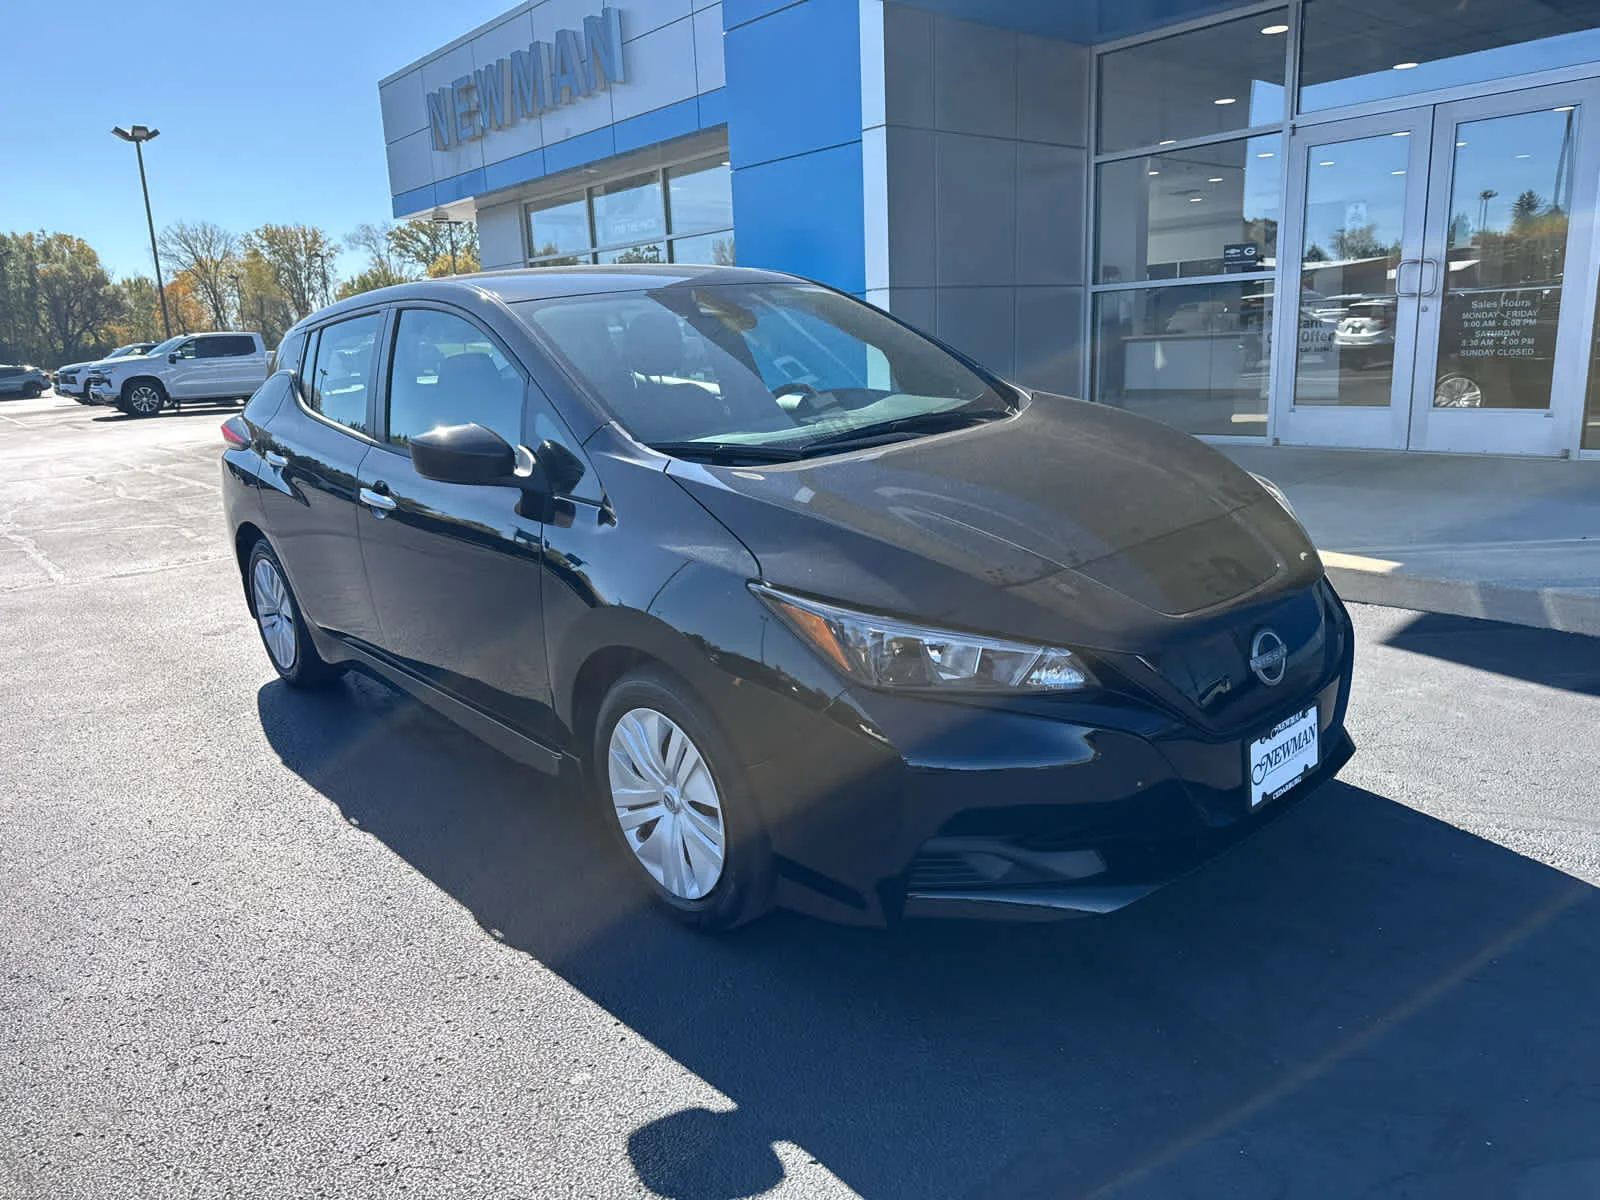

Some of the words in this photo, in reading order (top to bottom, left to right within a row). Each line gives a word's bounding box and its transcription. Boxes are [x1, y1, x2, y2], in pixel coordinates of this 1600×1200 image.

[426, 7, 625, 151] NEWMAN
[1471, 300, 1498, 309] Sales
[1501, 299, 1531, 308] Hours
[1462, 311, 1497, 320] MONDAY
[1506, 310, 1538, 318] FRIDAY
[1482, 319, 1496, 327] AM
[1522, 318, 1537, 326] PM
[1474, 329, 1521, 338] SATURDAY
[1480, 338, 1494, 346] AM
[1521, 337, 1535, 345] PM
[1460, 348, 1495, 357] SUNDAY
[1497, 348, 1535, 356] CLOSED
[1252, 723, 1317, 786] NEWMAN
